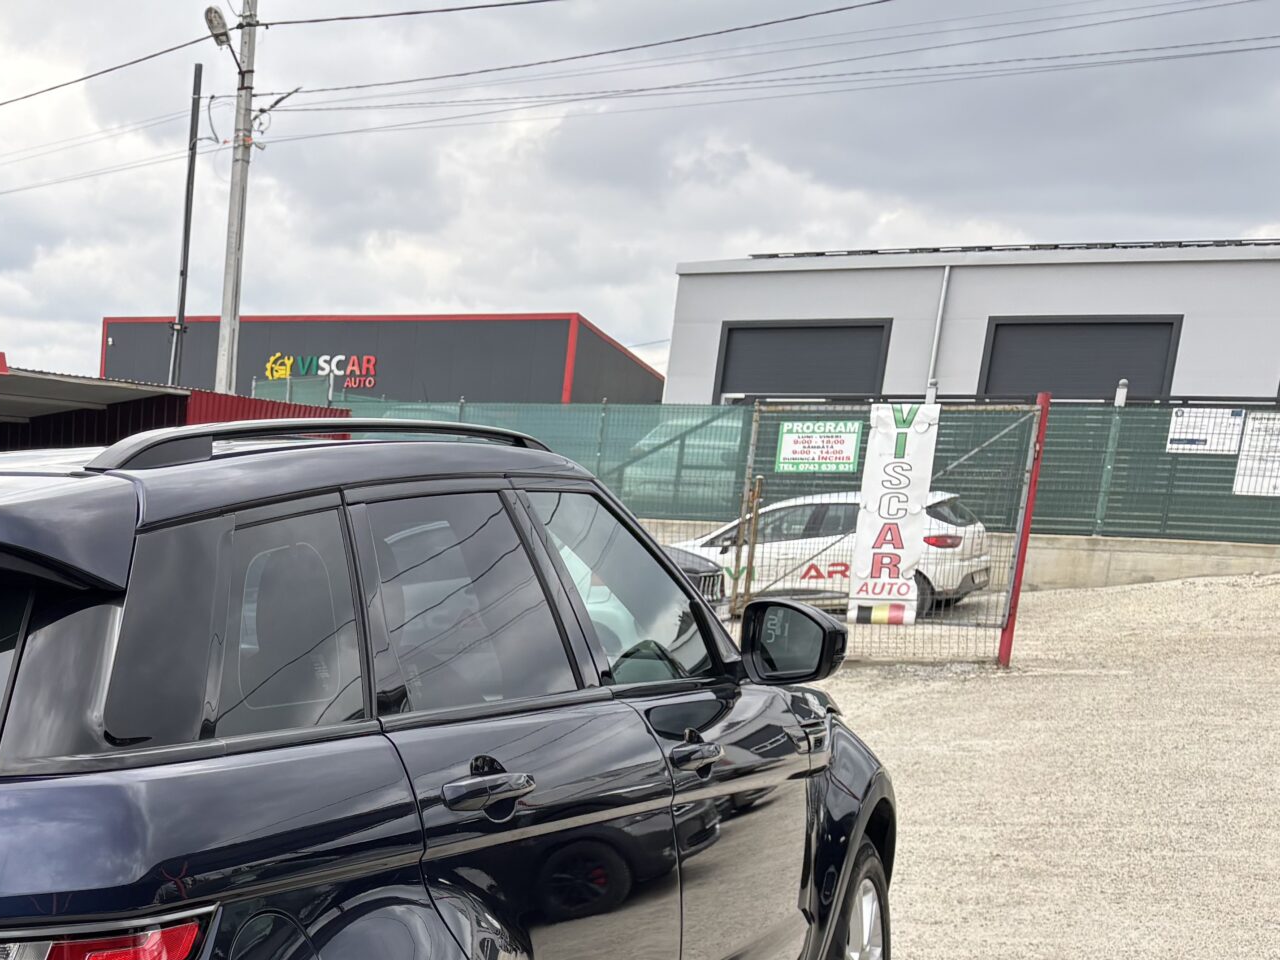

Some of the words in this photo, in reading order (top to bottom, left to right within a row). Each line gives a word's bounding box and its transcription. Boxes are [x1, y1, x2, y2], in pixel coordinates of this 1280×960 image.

[297, 355, 376, 375] VISCAR
[344, 377, 375, 388] AUTO
[783, 422, 860, 433] PROGRAM
[869, 403, 920, 579] VISCAR
[856, 582, 910, 596] AUTO
